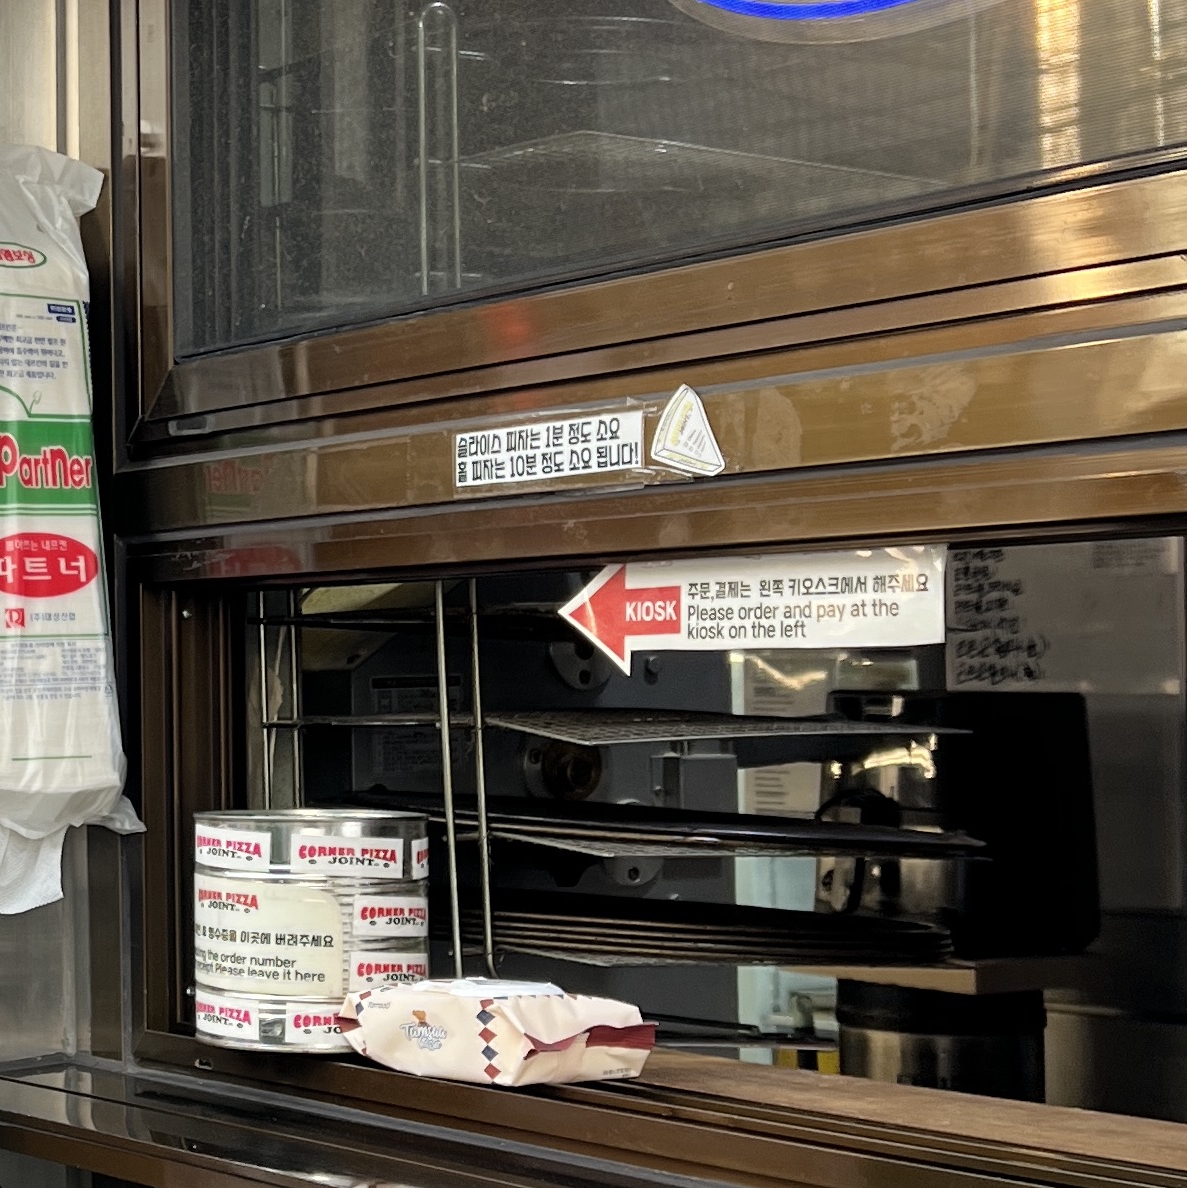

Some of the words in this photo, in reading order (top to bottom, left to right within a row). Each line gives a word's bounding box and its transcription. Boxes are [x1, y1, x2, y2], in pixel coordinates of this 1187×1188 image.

[458, 431, 501, 458] 슬라이스
[506, 427, 541, 453] 피자는
[546, 424, 564, 447] 1분
[568, 421, 592, 445] 정도
[597, 418, 620, 442] 소요
[472, 457, 505, 481] 피자는
[509, 453, 537, 477] 10분
[541, 451, 562, 473] 정도
[569, 448, 592, 470] 소요
[597, 442, 639, 468] 됩니다!
[687, 579, 751, 601] 주문,결제는
[759, 580, 785, 598] 왼쪽
[788, 575, 867, 597] 키오스크에서
[872, 573, 929, 594] 해주세요
[625, 600, 677, 622] KIOSK
[687, 602, 734, 622] Please
[737, 602, 781, 620] order
[783, 600, 812, 619] and
[816, 601, 845, 622] pay
[850, 600, 867, 618] at
[871, 598, 899, 617] the
[687, 621, 725, 640] kiosk
[728, 624, 748, 639] on
[751, 620, 776, 639] the
[780, 620, 807, 639] left
[207, 848, 239, 859] JOINT
[226, 840, 262, 858] PIZZA
[298, 845, 356, 860] CORNER
[361, 848, 398, 864] PIZZA
[328, 857, 375, 867] JOINT
[208, 901, 237, 912] JOINT
[226, 892, 258, 910] PIZZA
[360, 906, 406, 920] CORNER
[386, 918, 417, 926] JOINT
[240, 930, 271, 945] 이곳에
[275, 933, 334, 948] 버려주세요
[220, 953, 246, 965] order
[250, 956, 297, 968] number
[215, 963, 245, 977] Please
[247, 967, 280, 980] leave
[283, 969, 292, 981] it
[295, 970, 326, 982] here
[357, 963, 403, 977] CORNER
[203, 1013, 230, 1026] JOINT
[219, 1006, 251, 1025] PIZZA
[293, 1013, 340, 1029] CORNE
